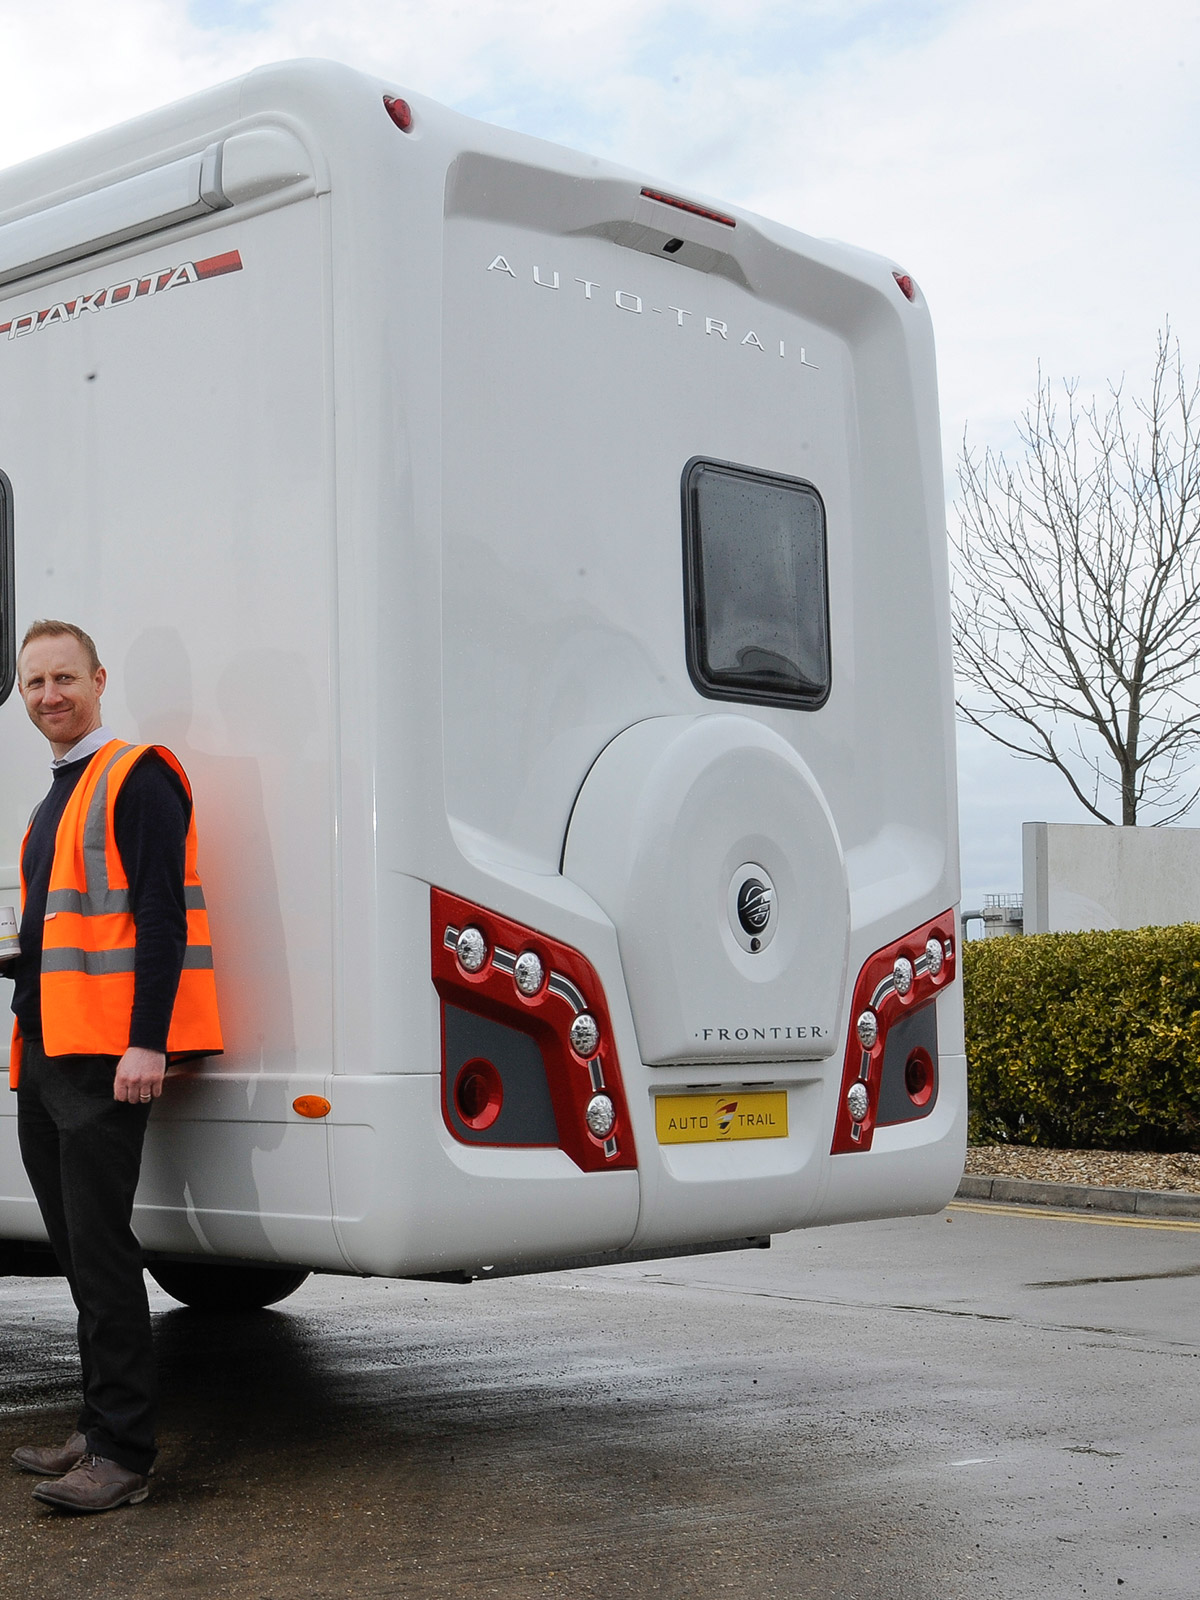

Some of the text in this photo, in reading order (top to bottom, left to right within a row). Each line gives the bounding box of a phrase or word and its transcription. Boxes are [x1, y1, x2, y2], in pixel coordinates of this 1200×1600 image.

[7, 261, 200, 341] DAKOTA
[486, 254, 820, 371] AUTO-TRAIL
[702, 1026, 823, 1041] FRONTIER
[668, 1113, 776, 1130] AUTO TRAIL
